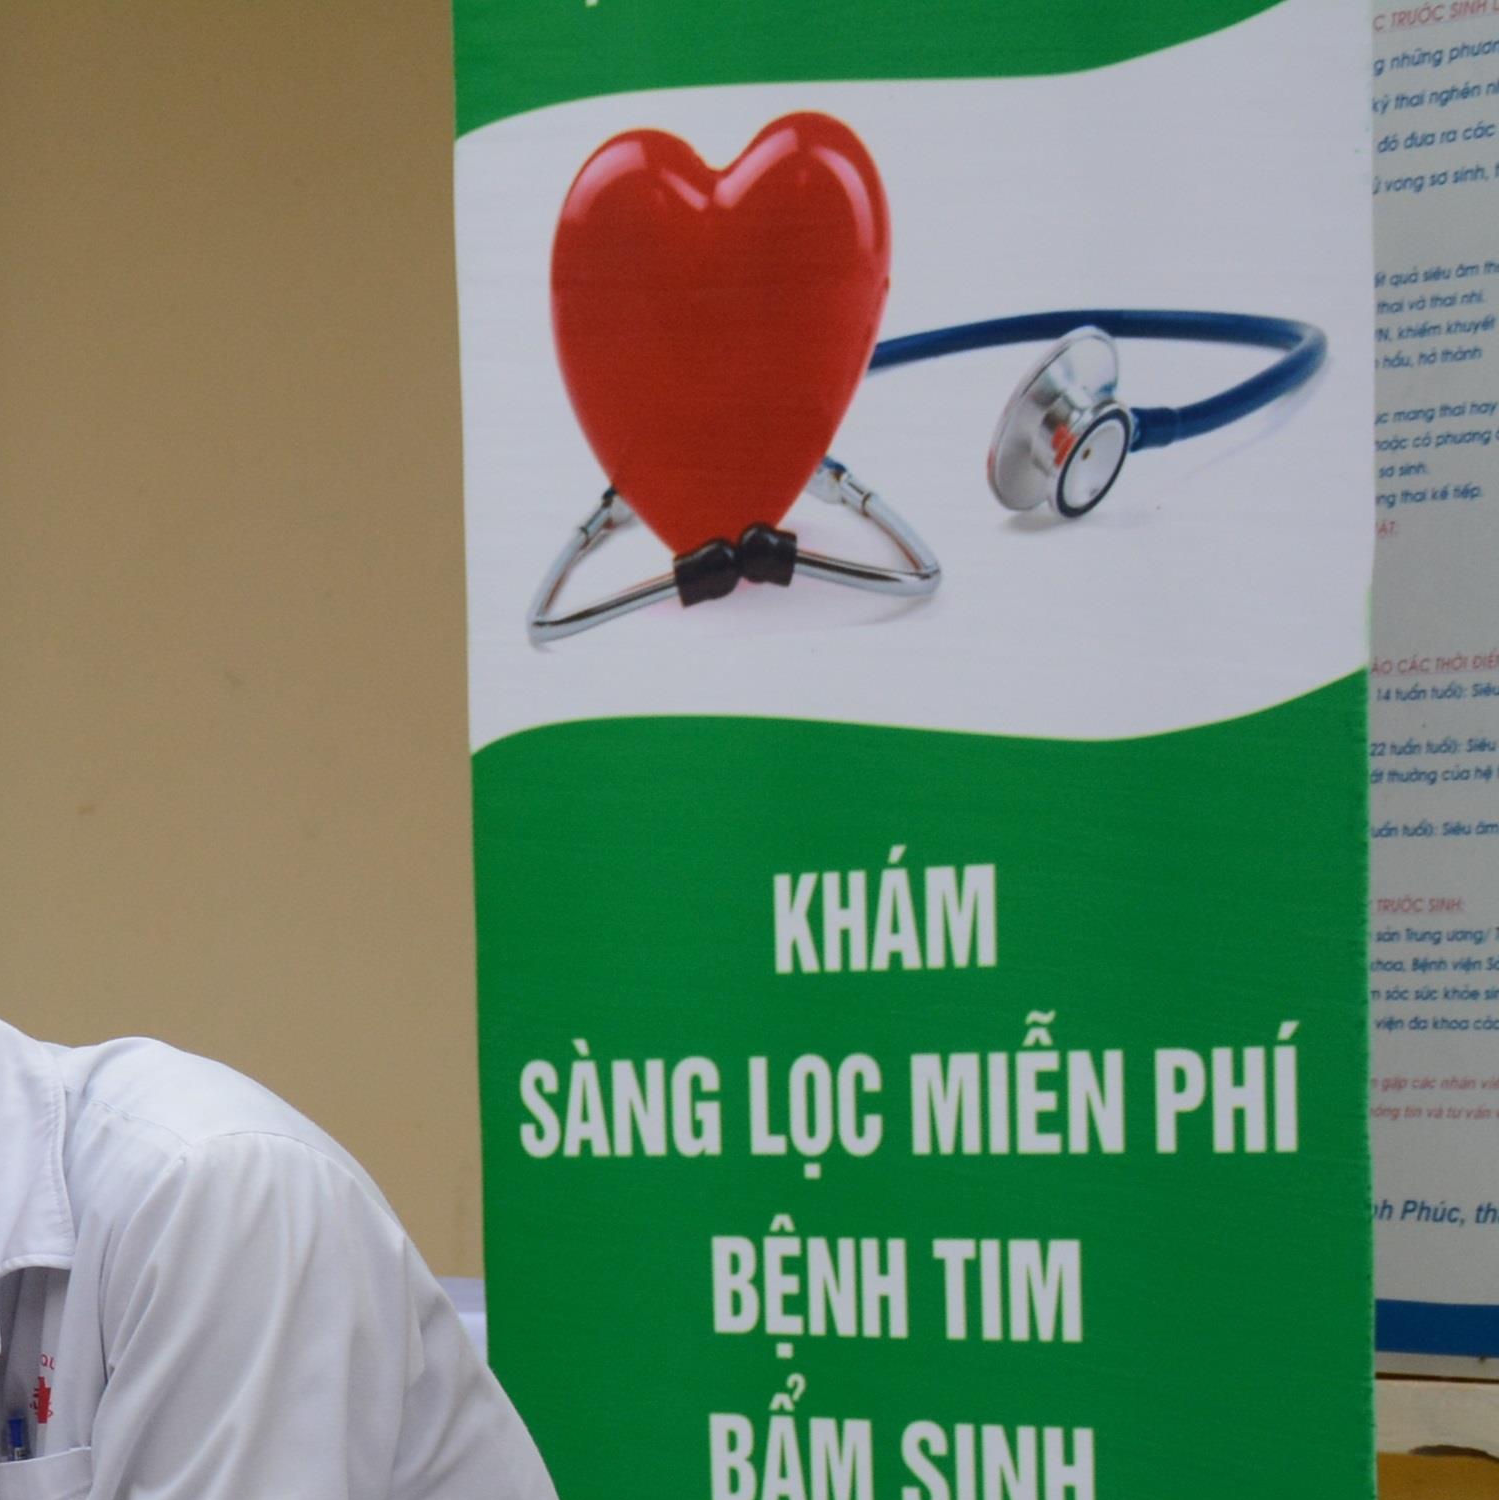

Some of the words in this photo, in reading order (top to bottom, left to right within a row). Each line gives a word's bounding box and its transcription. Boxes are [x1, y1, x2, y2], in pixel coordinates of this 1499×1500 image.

[1394, 90, 1425, 110] thai
[1439, 129, 1457, 144] ra
[1462, 120, 1496, 140] các
[1385, 175, 1424, 193] vong
[773, 844, 998, 975] KHÁM
[519, 1037, 722, 1159] SÀNG
[748, 1054, 883, 1180] LỌC
[911, 1010, 1126, 1157] MIỄN
[1155, 1020, 1300, 1154] PHÍ
[1400, 1200, 1466, 1226] Phúc,
[711, 1214, 909, 1359] BỆNH
[933, 1238, 1084, 1343] TIM
